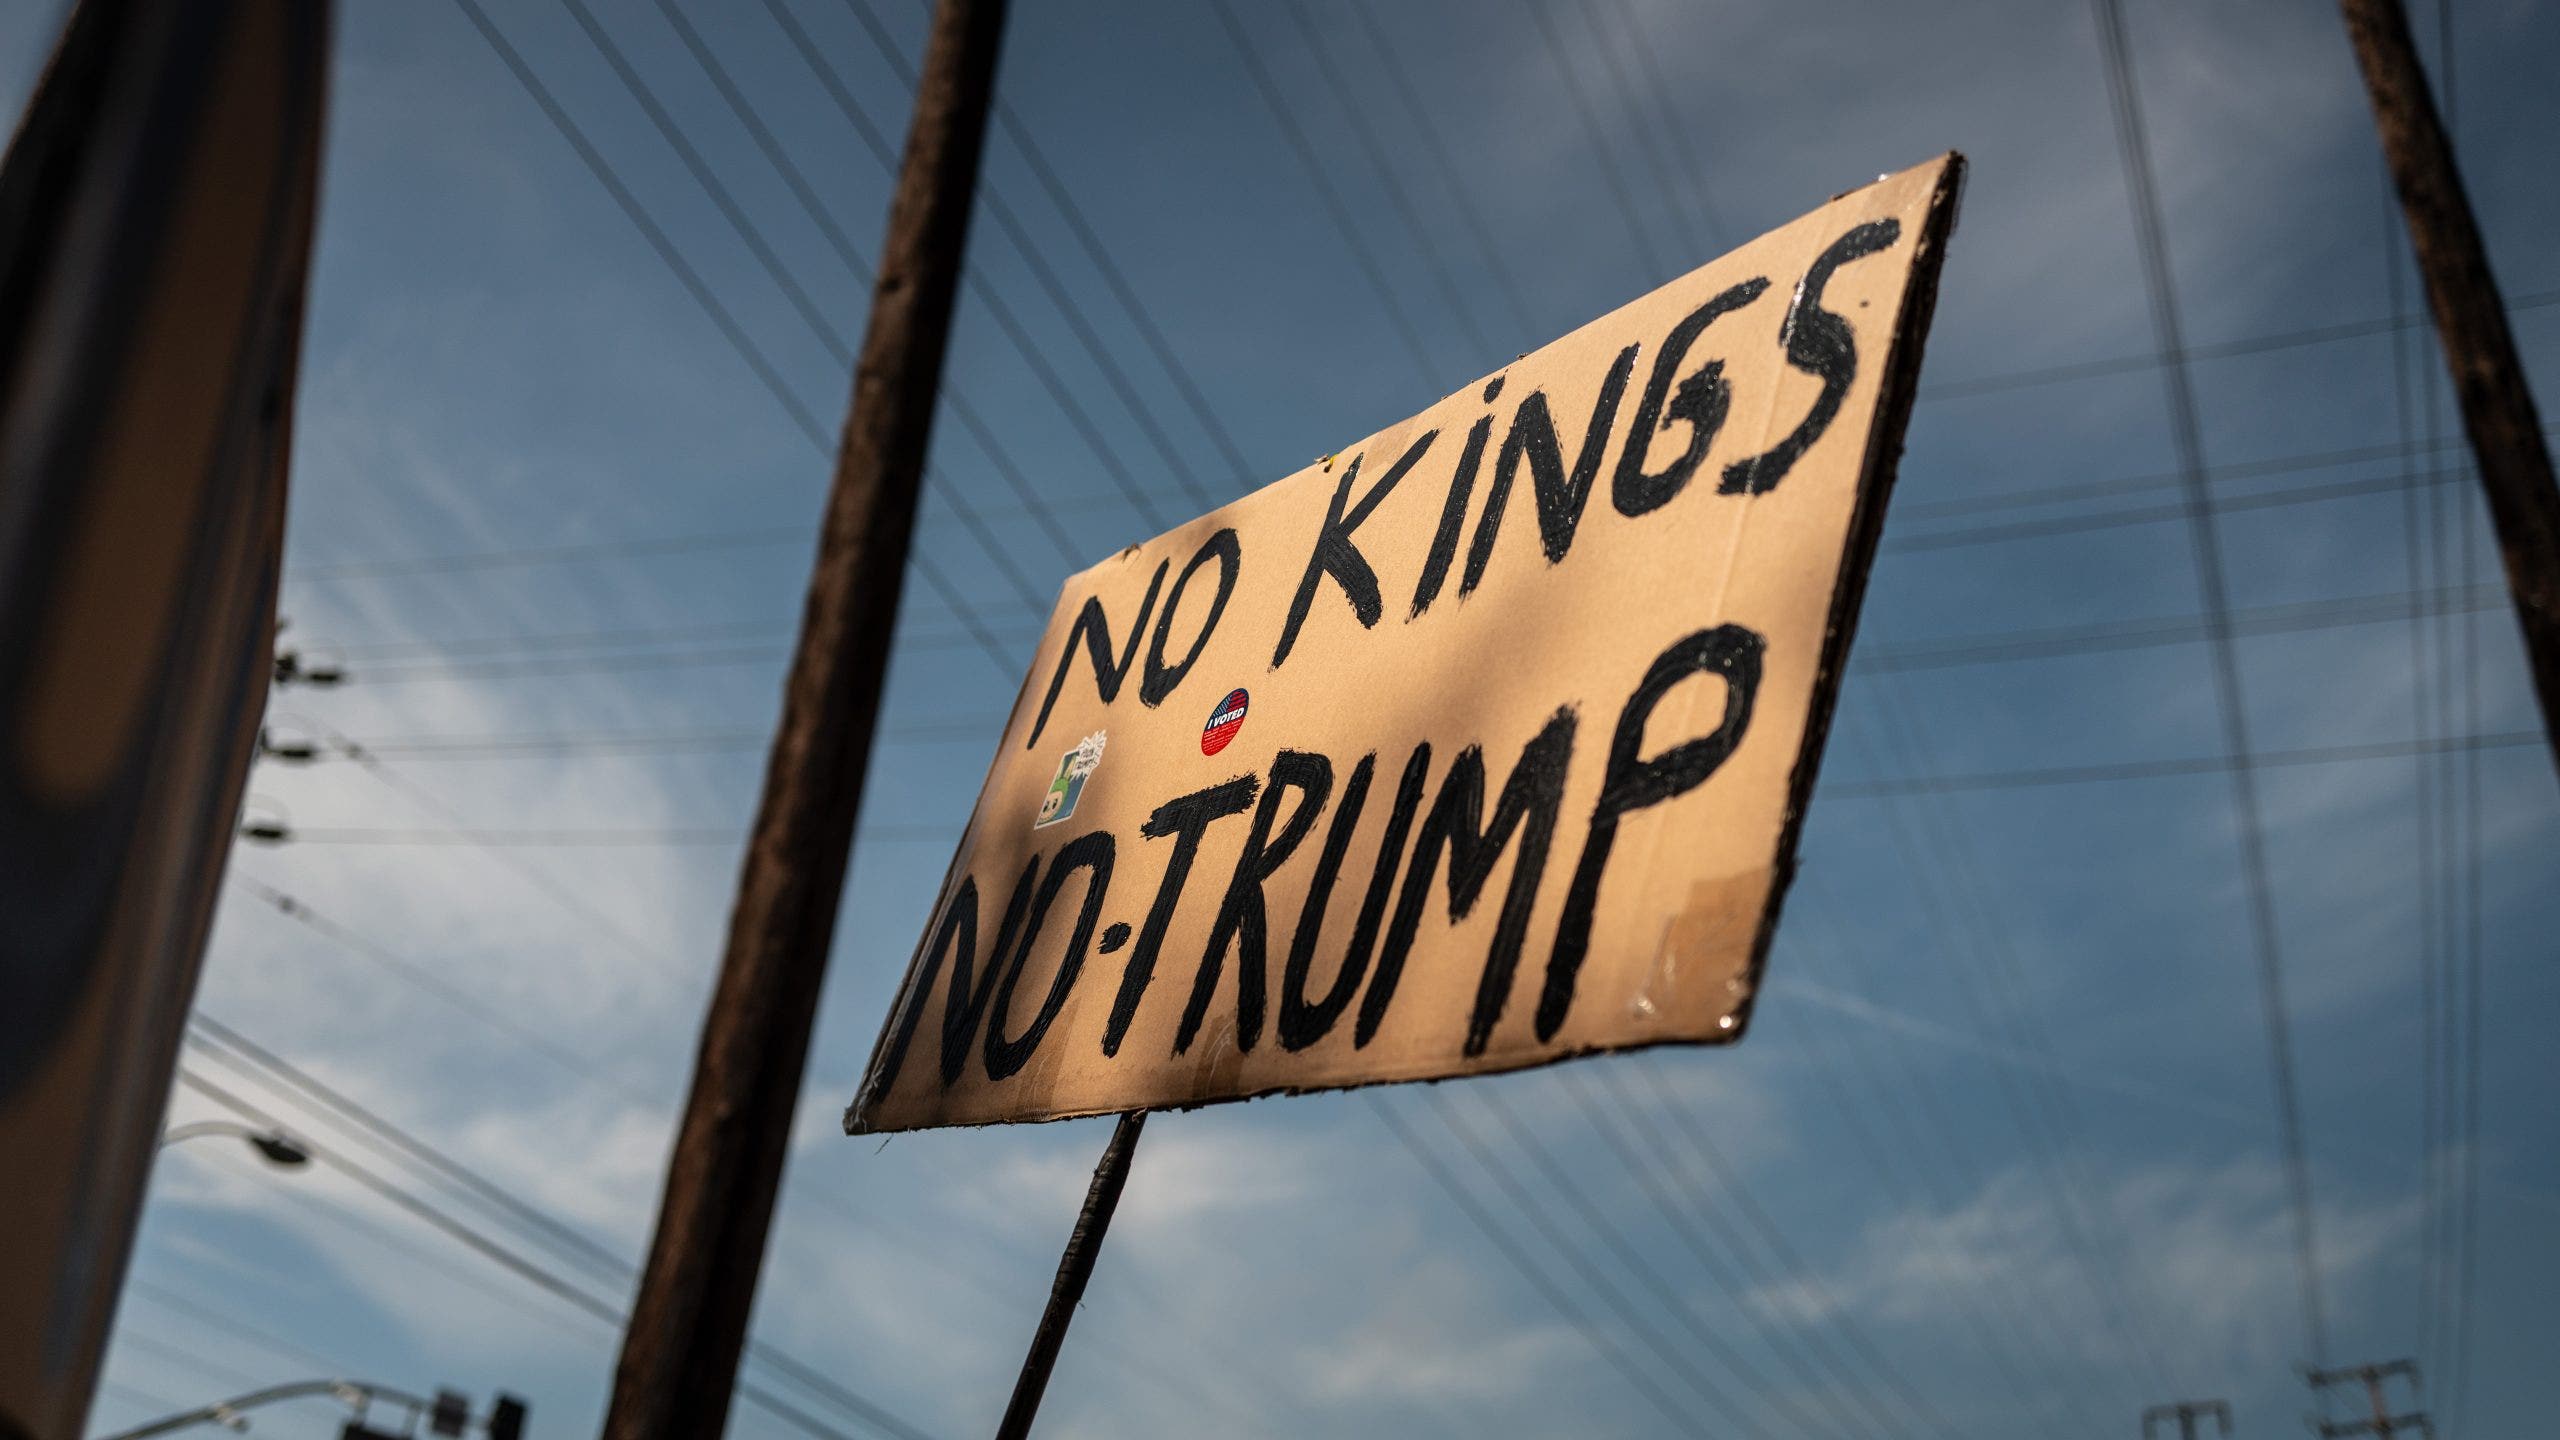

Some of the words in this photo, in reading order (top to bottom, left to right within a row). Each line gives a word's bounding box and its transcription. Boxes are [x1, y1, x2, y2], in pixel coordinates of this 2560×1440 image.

[1027, 528, 1242, 751] NO
[1207, 718, 1214, 730] I
[1213, 707, 1245, 728] VOTED
